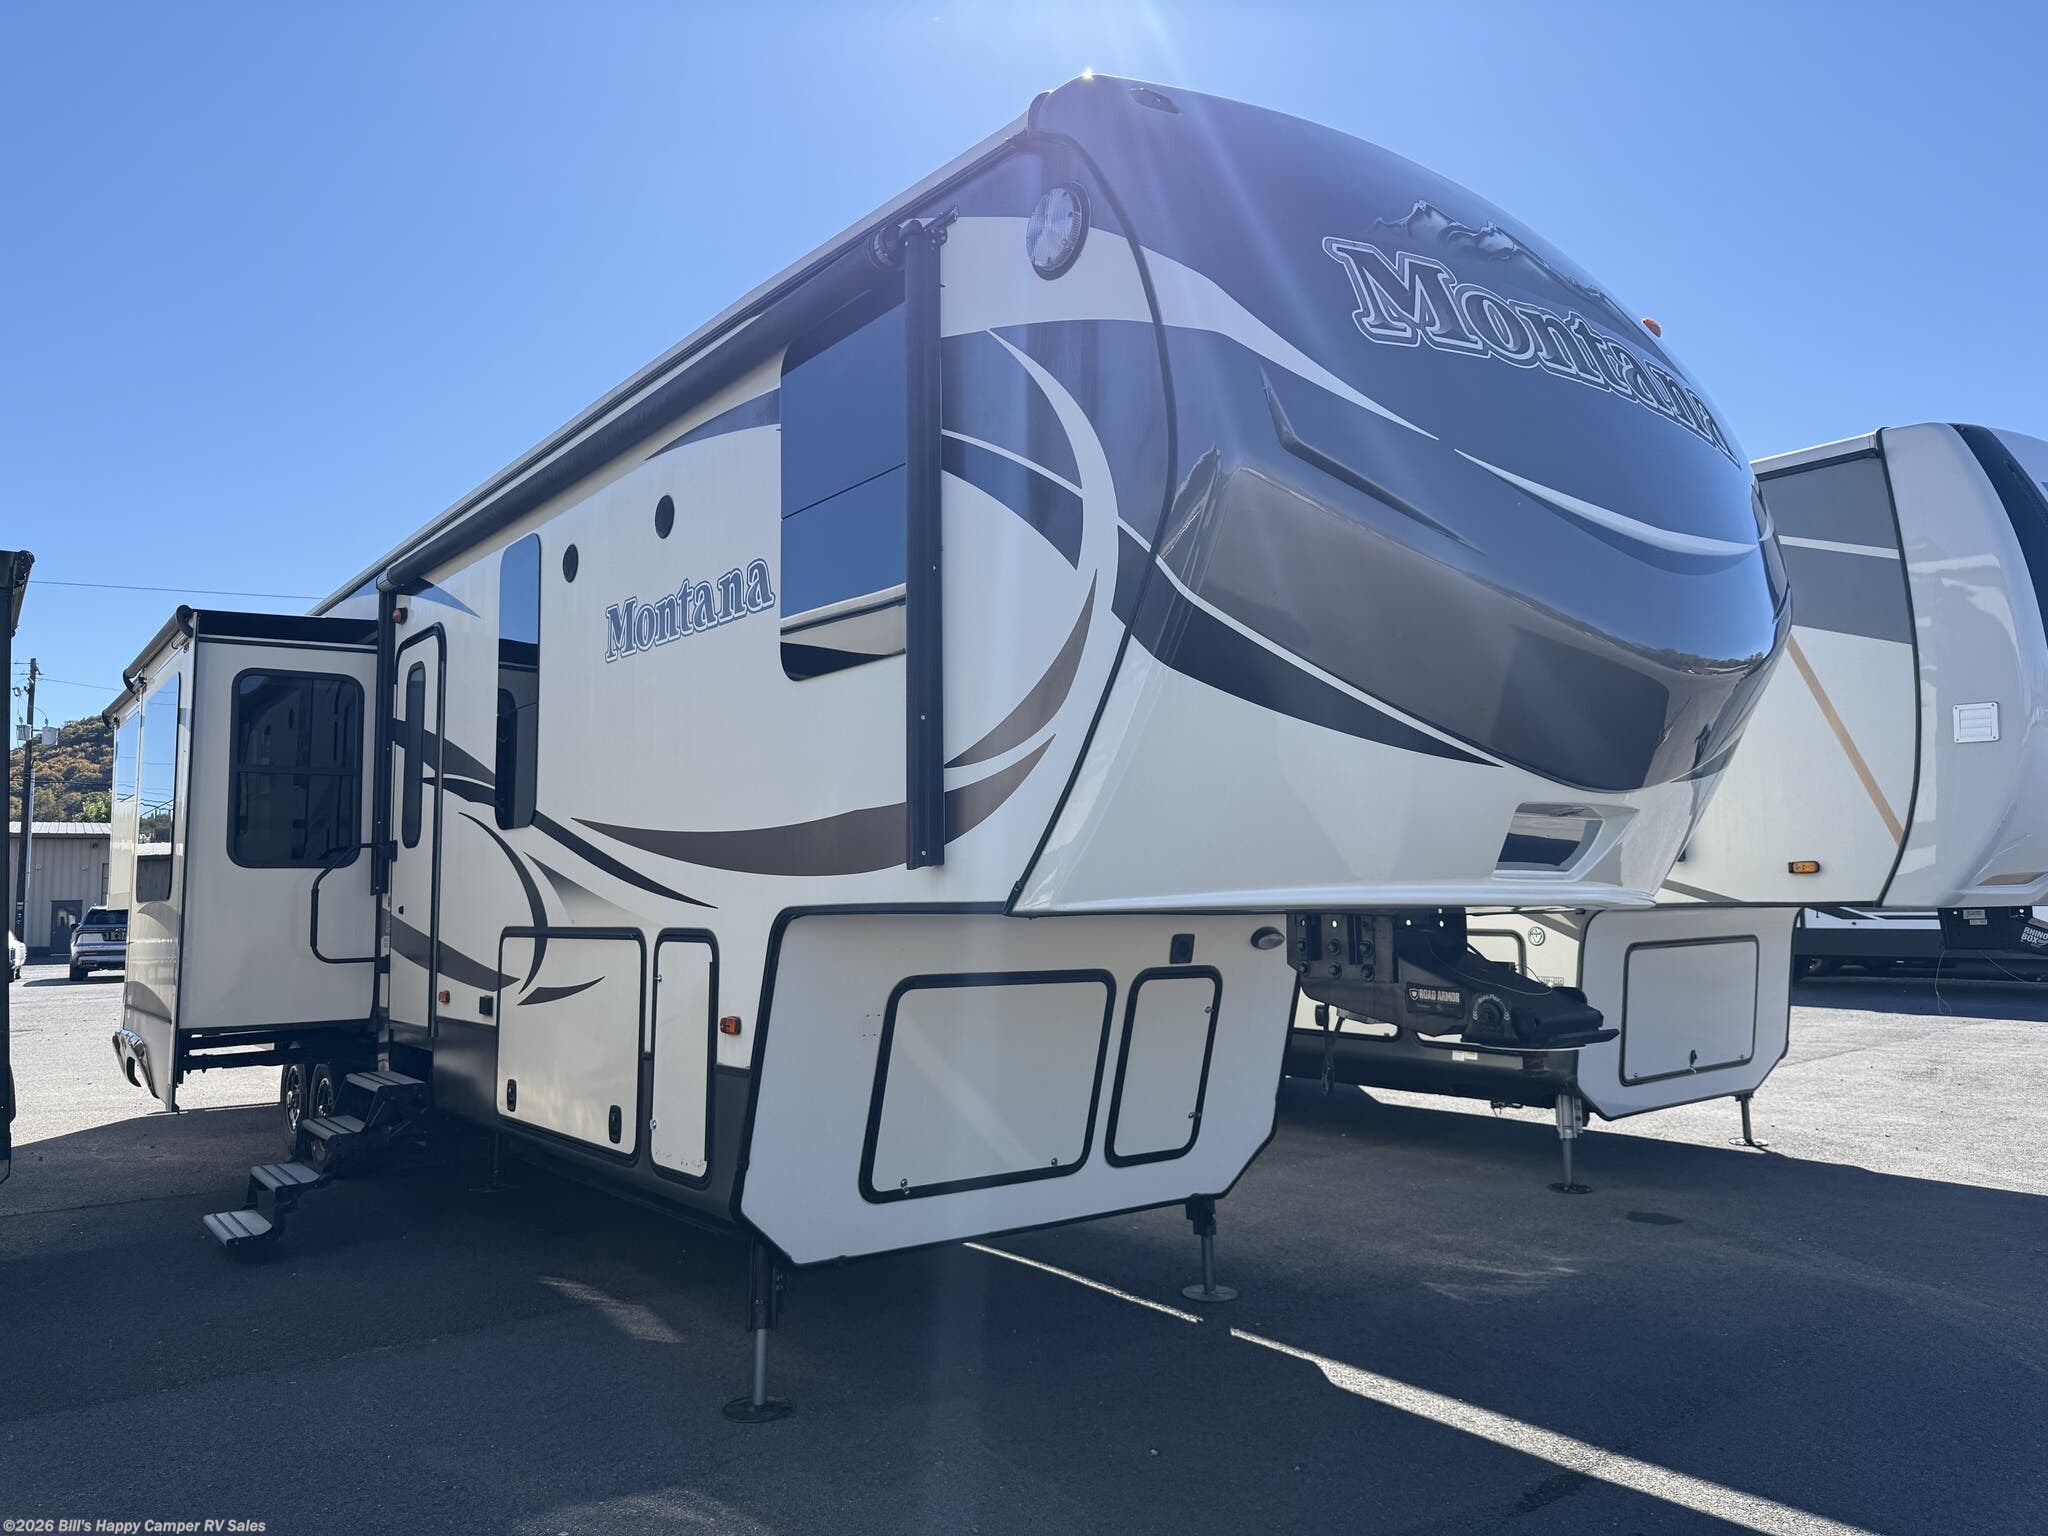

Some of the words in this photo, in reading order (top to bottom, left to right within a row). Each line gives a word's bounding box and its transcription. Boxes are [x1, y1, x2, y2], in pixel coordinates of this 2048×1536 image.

[1322, 236, 1742, 471] Montana
[605, 558, 776, 664] Montana
[2021, 932, 2039, 944] BOX
[2023, 926, 2048, 940] RHINO
[1419, 988, 1437, 1001] ROAD
[1437, 990, 1460, 1003] ARMOR
